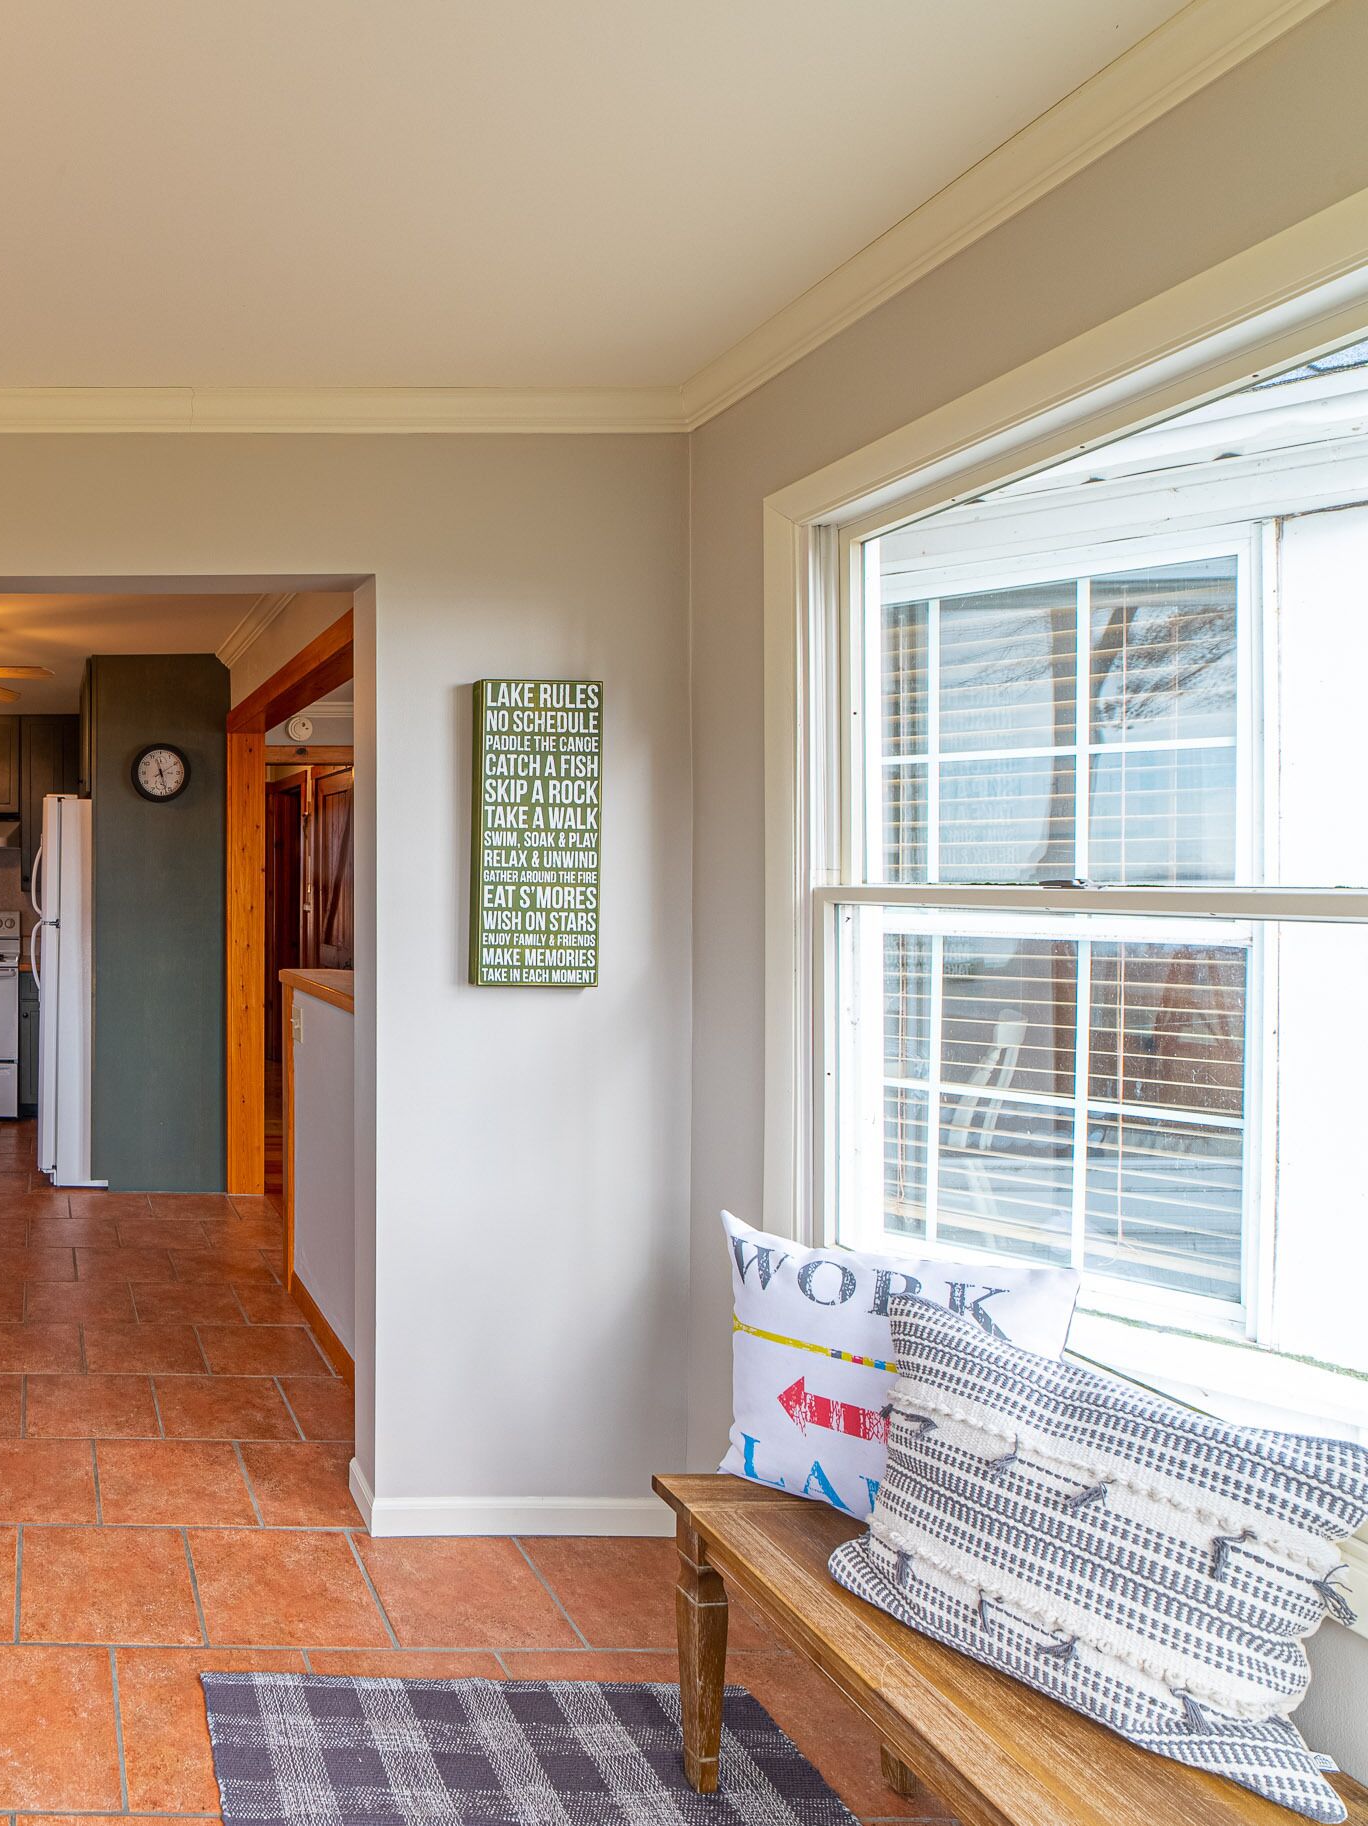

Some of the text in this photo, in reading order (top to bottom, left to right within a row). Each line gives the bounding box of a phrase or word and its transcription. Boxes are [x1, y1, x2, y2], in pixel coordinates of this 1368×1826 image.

[487, 683, 598, 708] LAKE RULES
[486, 710, 598, 733] NO SCHEDULE
[486, 736, 598, 752] PADDLE THE CANOE
[486, 754, 598, 778] CATCH A FISH
[485, 779, 598, 804] SKIP A ROCK
[485, 806, 598, 829] TAKE A WALK
[484, 831, 598, 848] SWIM, SOAK & PLAY
[484, 850, 597, 868] RELAX & UNWIND
[484, 870, 597, 884] GATHER AROUND THE FIRE
[484, 885, 597, 909] EAT S'MORES
[483, 911, 596, 931] WISH ON STARS
[483, 933, 596, 946] ENJOY FAMILY & FRIENDS
[482, 948, 595, 967] MAKE MEMORIES
[482, 968, 595, 983] TAKE IN EACH MOMENT
[730, 1235, 1012, 1342] WORK
